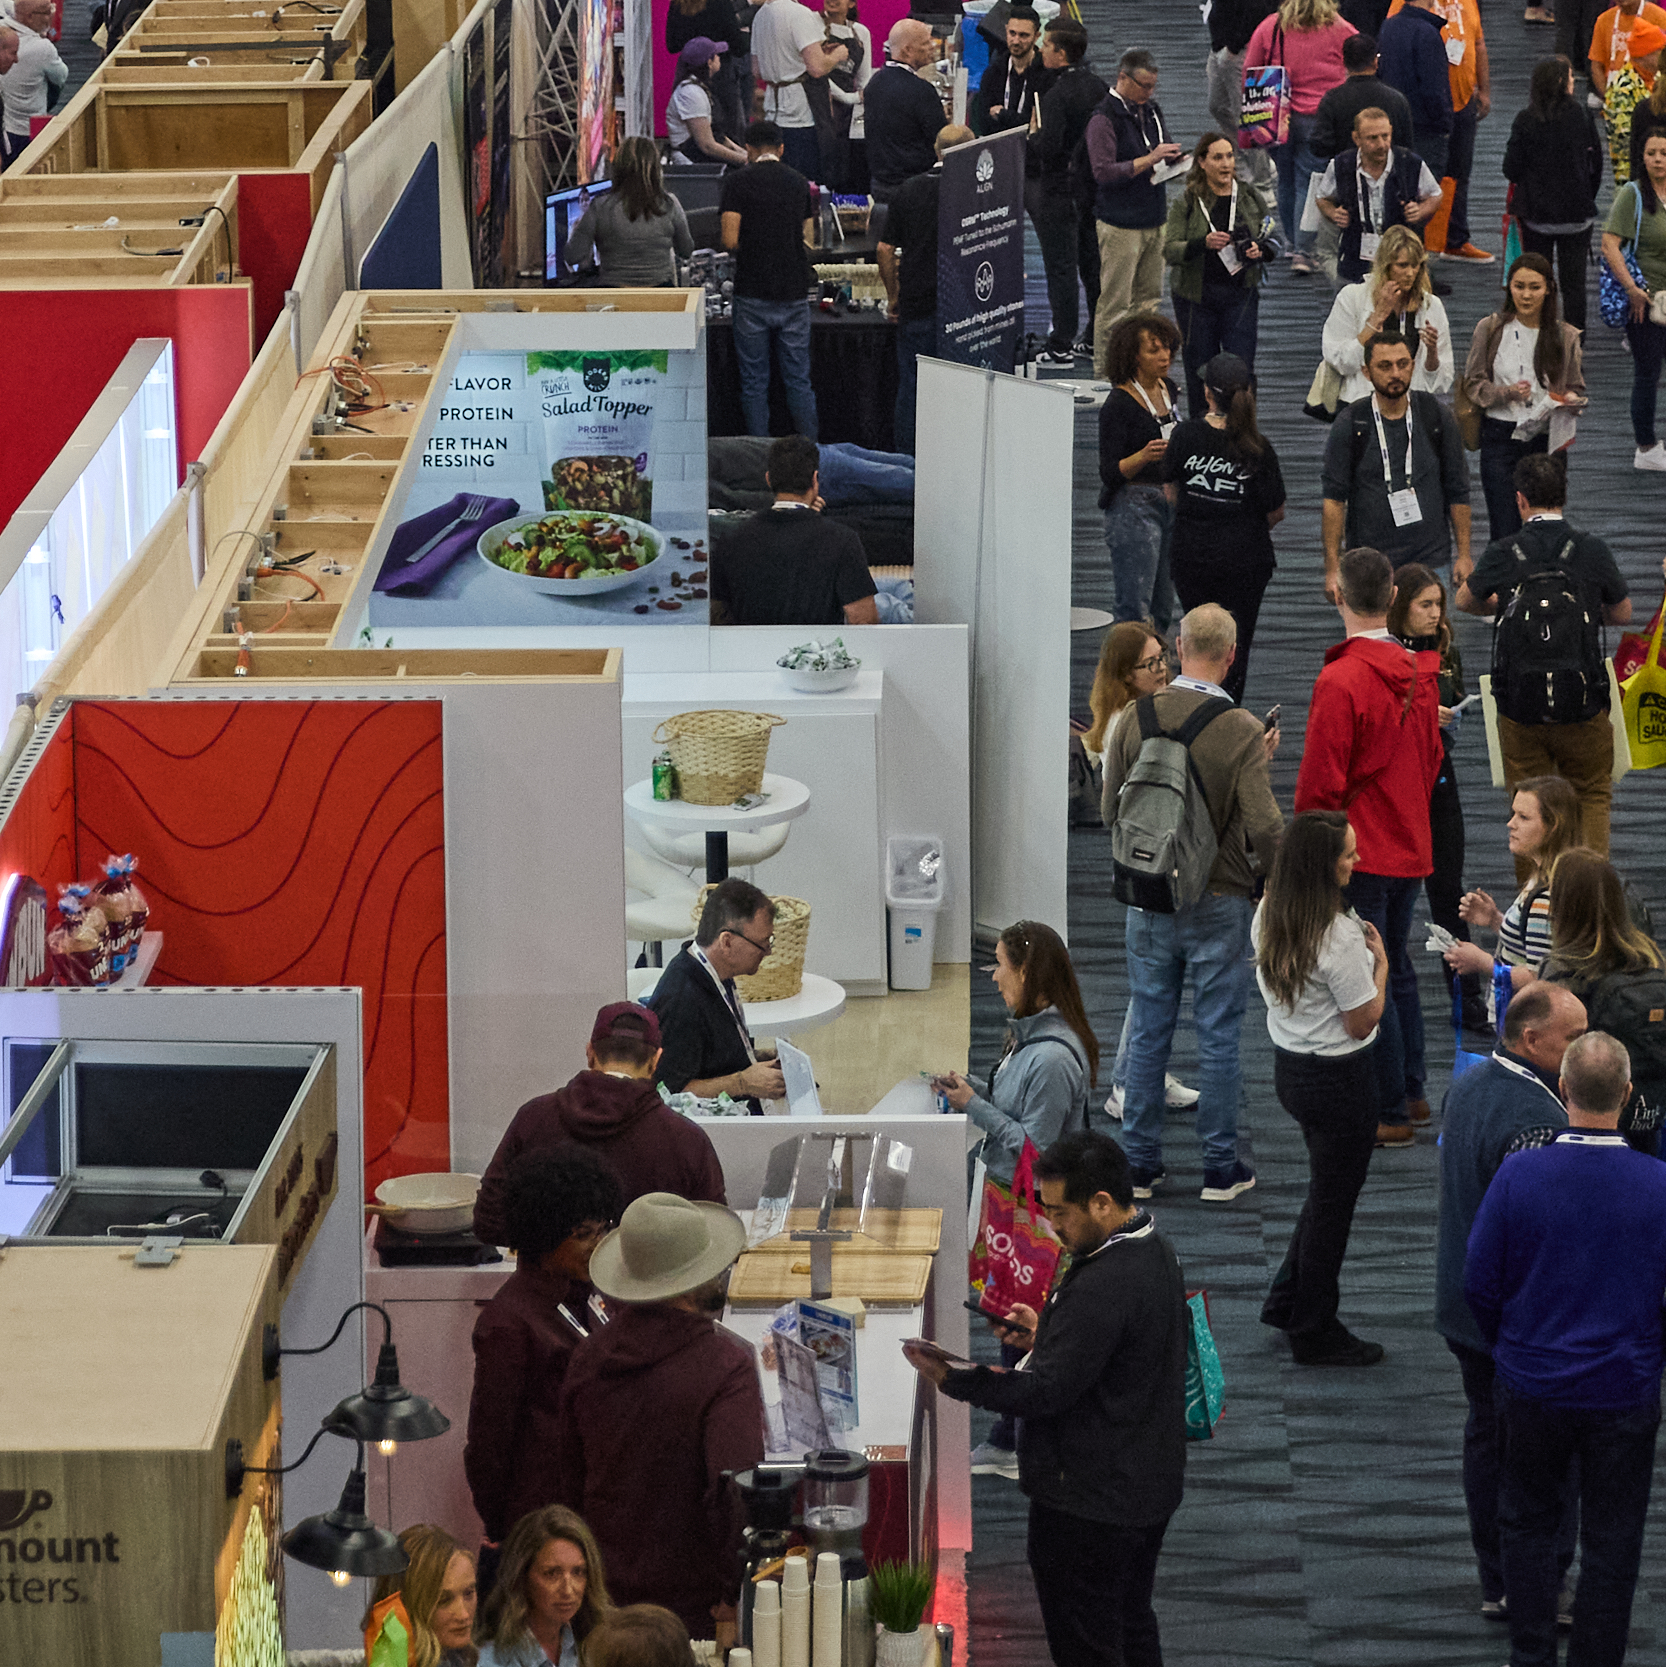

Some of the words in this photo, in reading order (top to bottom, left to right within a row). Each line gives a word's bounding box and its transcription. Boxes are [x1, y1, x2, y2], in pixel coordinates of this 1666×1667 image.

[975, 181, 994, 194] ALIGN
[540, 395, 593, 418] Salad
[592, 394, 654, 419] Topper
[440, 407, 514, 421] PROTEIN
[577, 424, 619, 434] PROTEIN
[460, 437, 508, 450] THAN
[422, 454, 495, 467] RESSING
